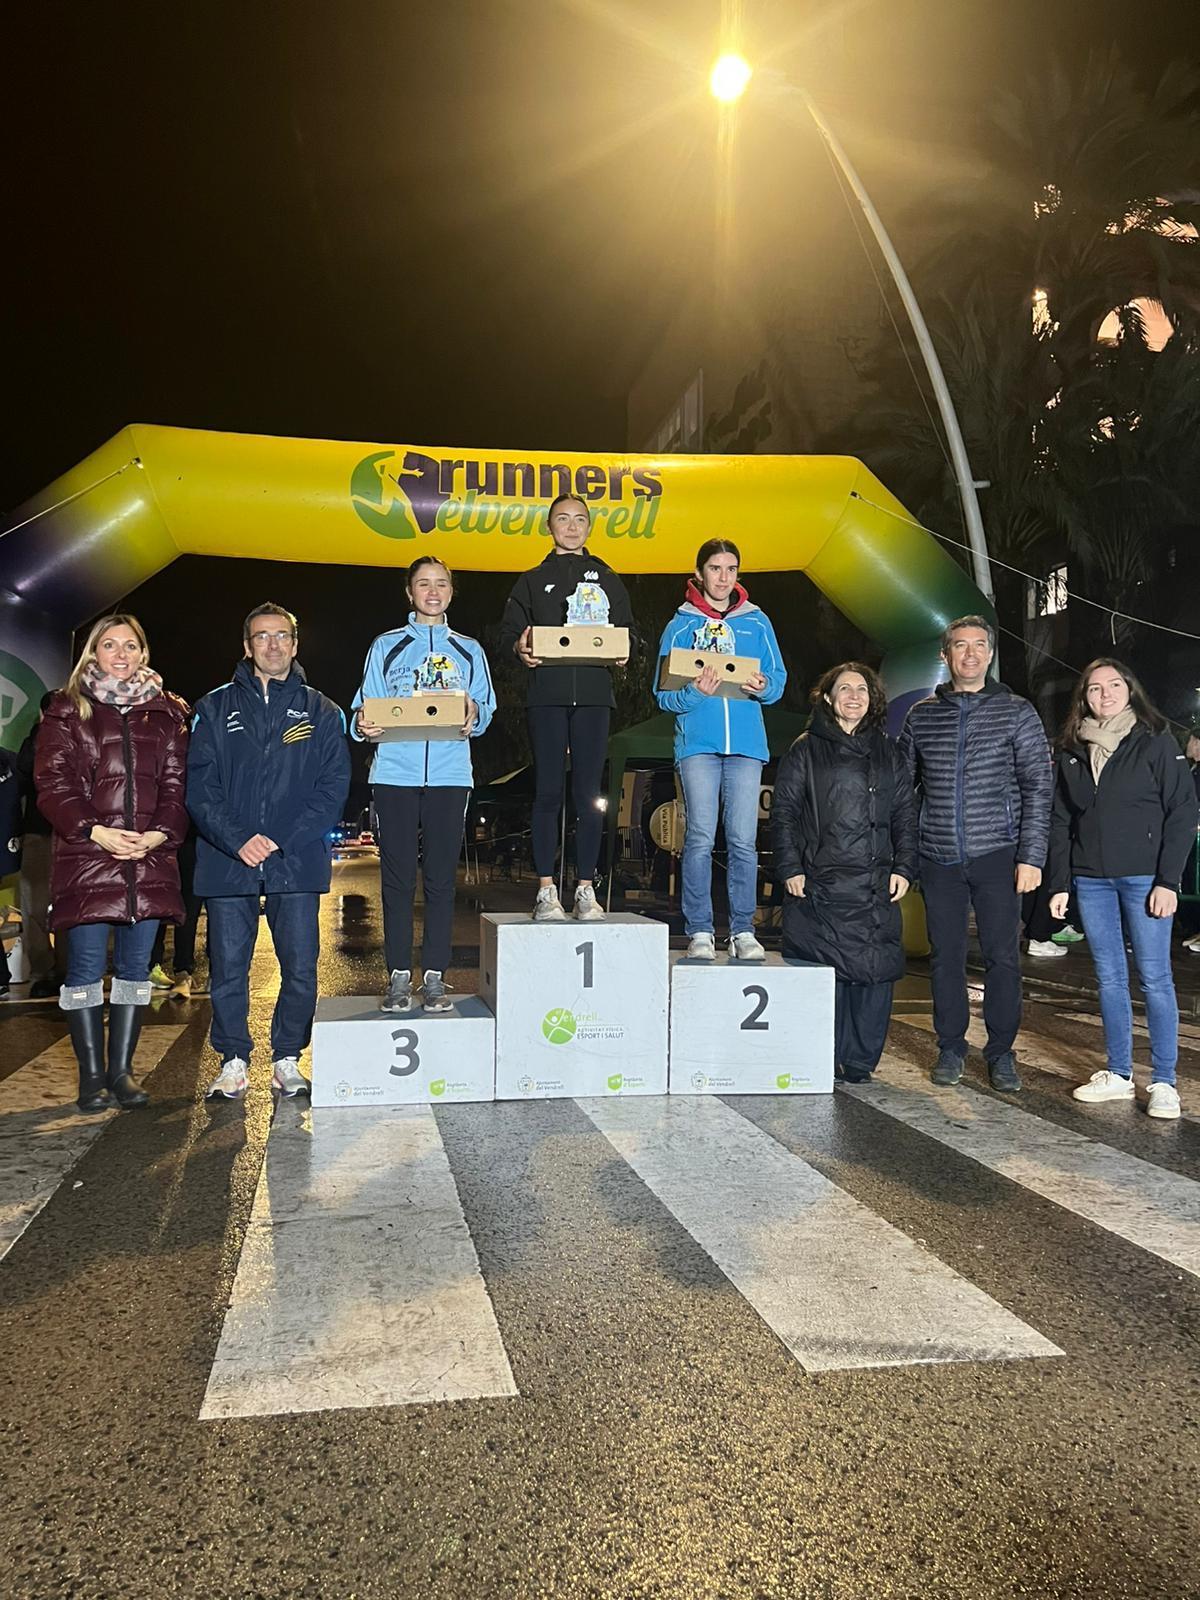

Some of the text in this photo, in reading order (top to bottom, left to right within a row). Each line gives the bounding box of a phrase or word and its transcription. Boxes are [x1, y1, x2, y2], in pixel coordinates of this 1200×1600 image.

[440, 458, 663, 501] runners
[437, 490, 660, 539] elvenrell
[575, 941, 593, 988] 1
[740, 984, 769, 1030] 2
[389, 1028, 420, 1077] 3
